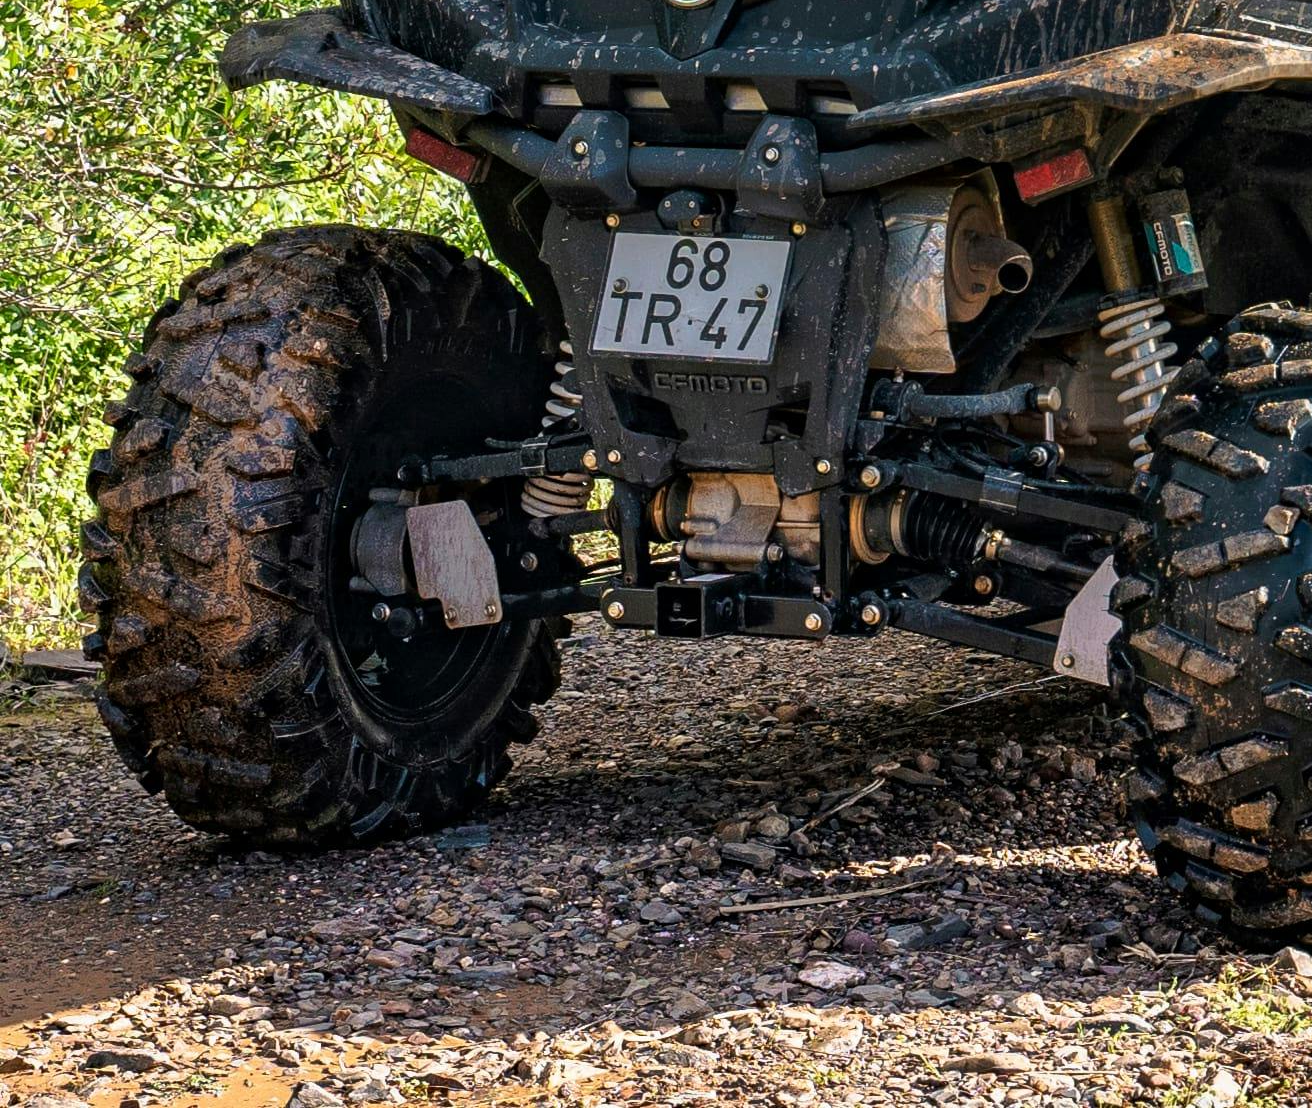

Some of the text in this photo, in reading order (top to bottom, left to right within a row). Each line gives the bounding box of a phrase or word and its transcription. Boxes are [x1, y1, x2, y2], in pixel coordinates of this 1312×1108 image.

[665, 238, 731, 292] 68
[1152, 221, 1174, 276] CFMOTO
[653, 372, 769, 394] CFMOTO
